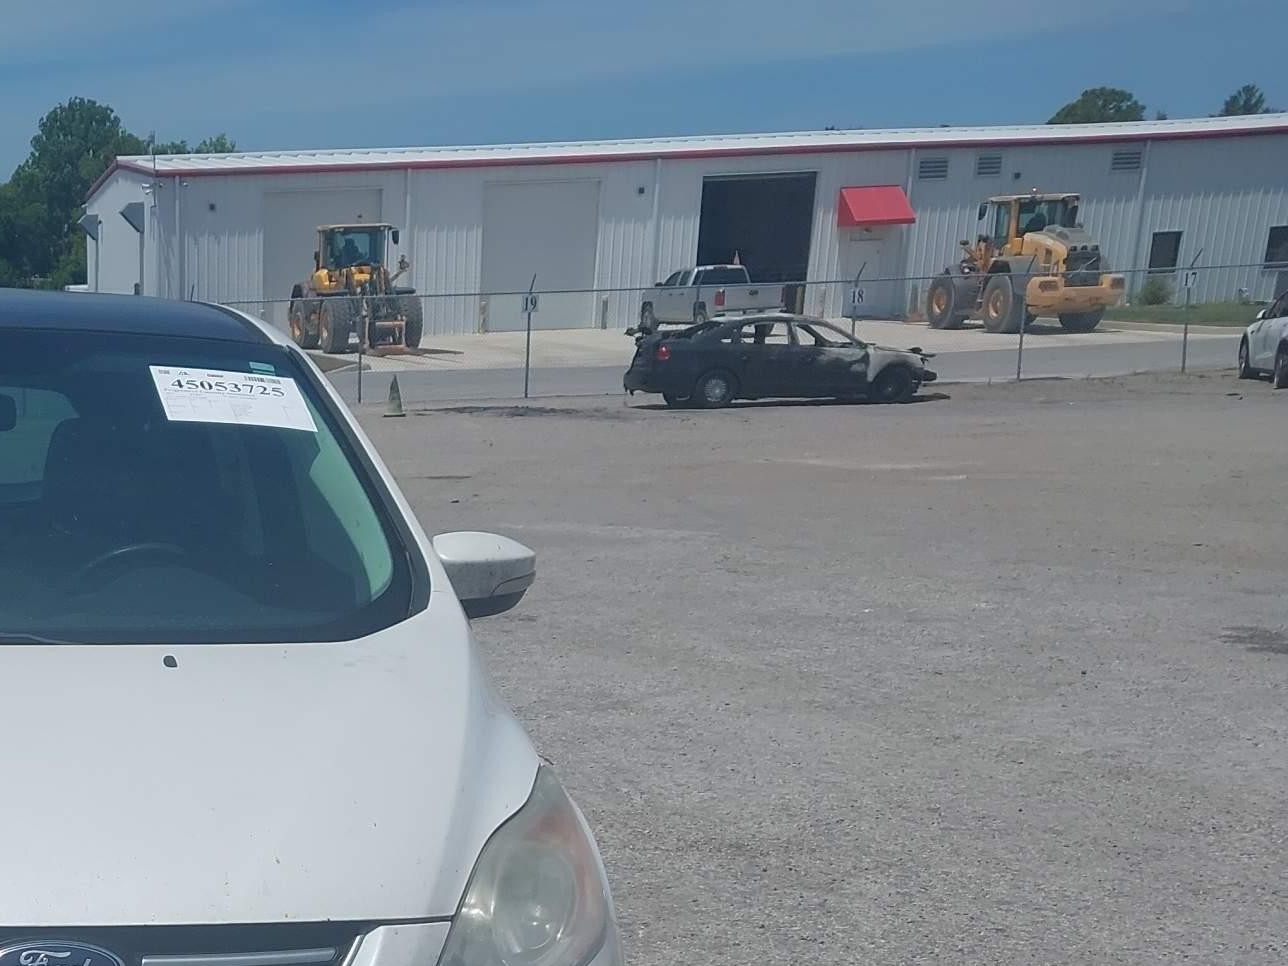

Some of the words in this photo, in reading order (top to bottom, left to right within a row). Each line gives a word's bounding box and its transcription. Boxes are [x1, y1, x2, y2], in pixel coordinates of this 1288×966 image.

[1185, 271, 1197, 286] 17
[524, 295, 537, 311] 19
[852, 289, 863, 304] 18
[171, 379, 285, 397] 45053725
